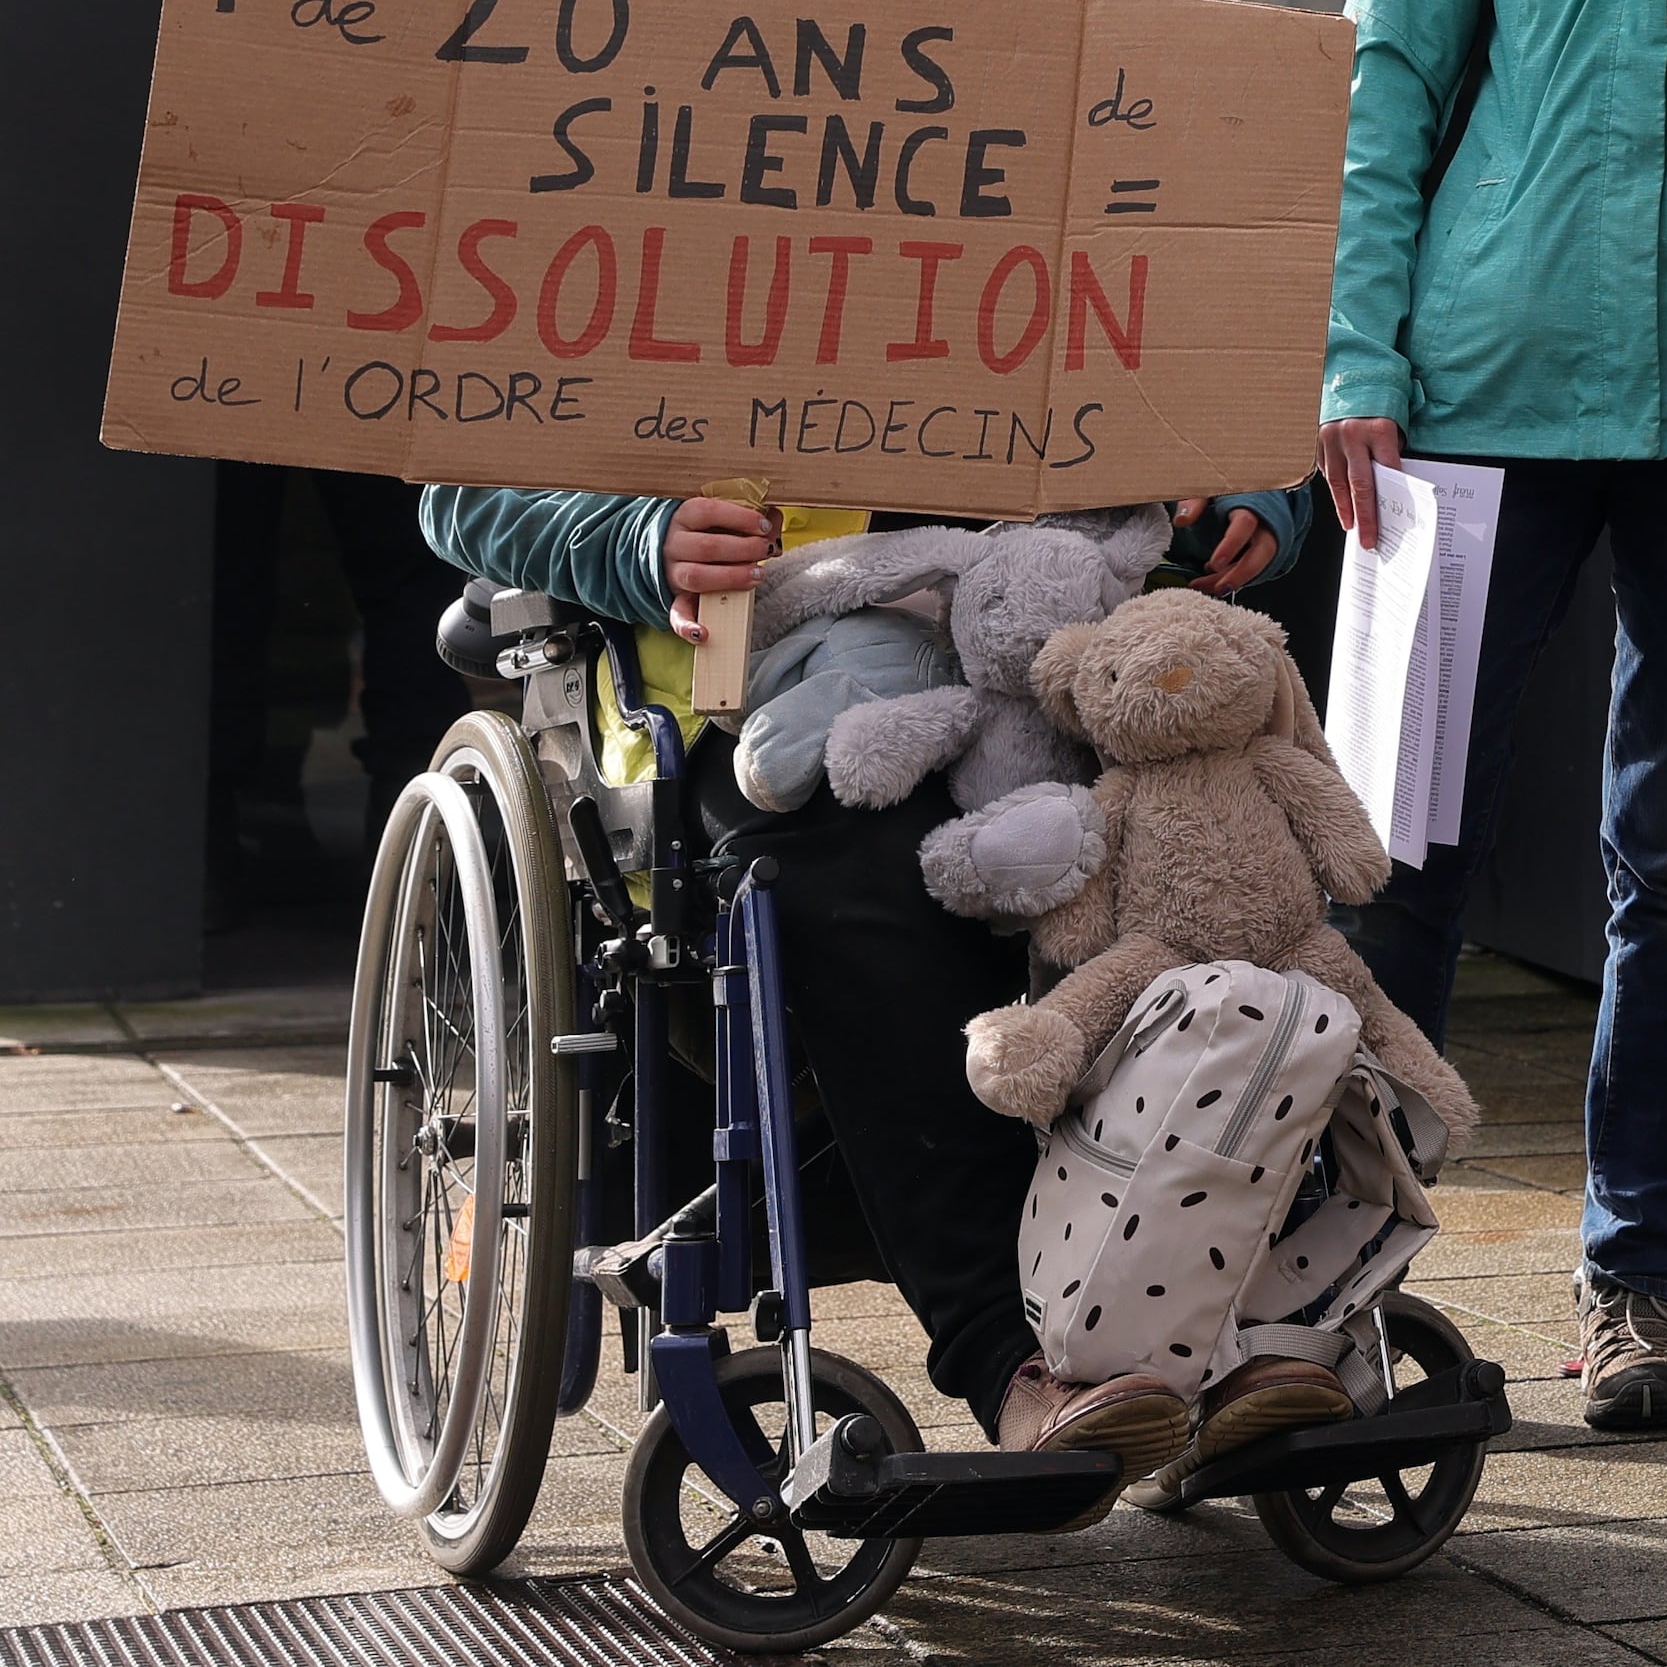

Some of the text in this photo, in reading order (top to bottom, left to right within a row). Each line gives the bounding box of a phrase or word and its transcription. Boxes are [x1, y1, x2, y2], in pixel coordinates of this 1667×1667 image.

[700, 15, 955, 114] ANS
[1088, 68, 1157, 130] de
[529, 86, 1027, 218] SILENCE
[167, 193, 1149, 375] DISSOLUTION
[170, 356, 1104, 468] de l'ORDRE des MÉDECINS
